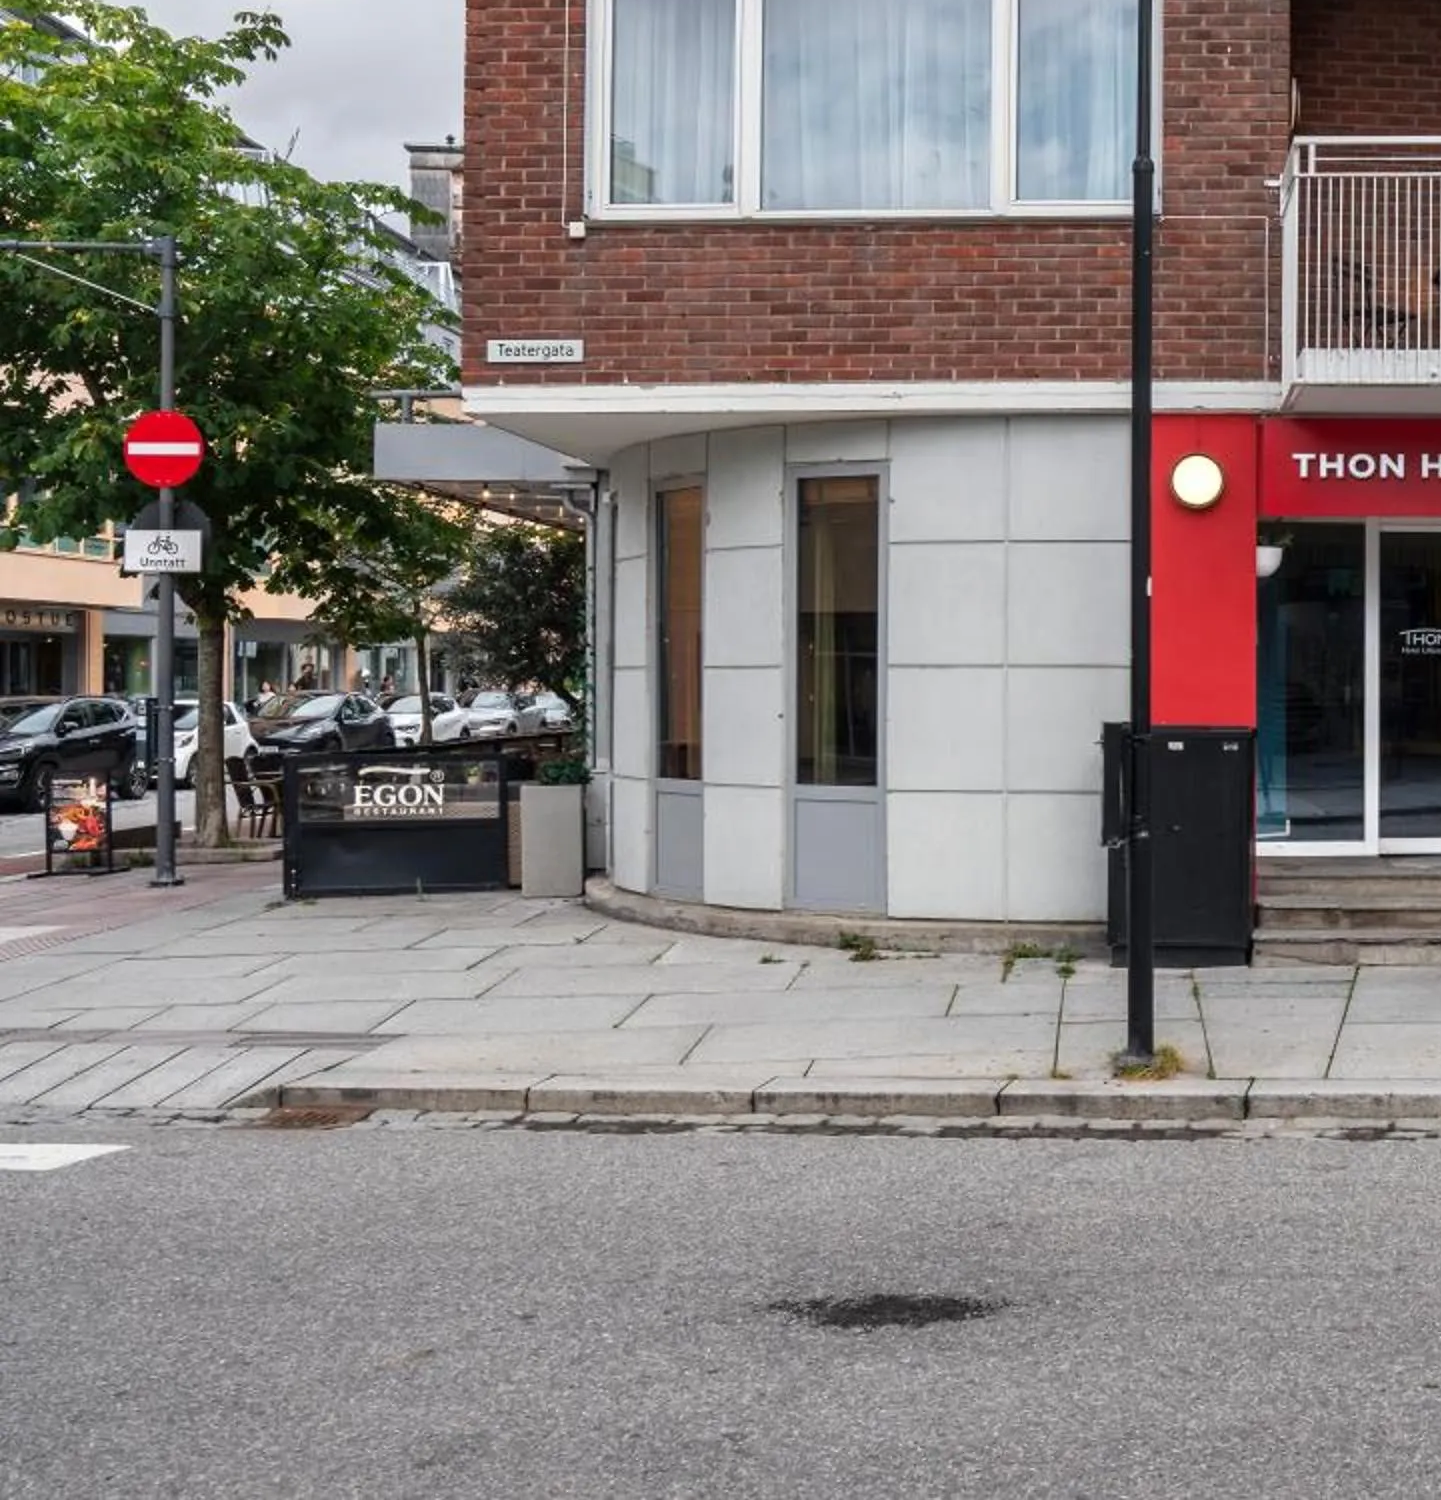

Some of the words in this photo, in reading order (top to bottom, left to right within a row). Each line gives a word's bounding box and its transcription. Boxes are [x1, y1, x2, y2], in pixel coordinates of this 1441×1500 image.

[497, 343, 575, 360] Teatergata
[1292, 453, 1405, 479] THON
[140, 557, 185, 568] Unntatt
[353, 784, 444, 806] EGON
